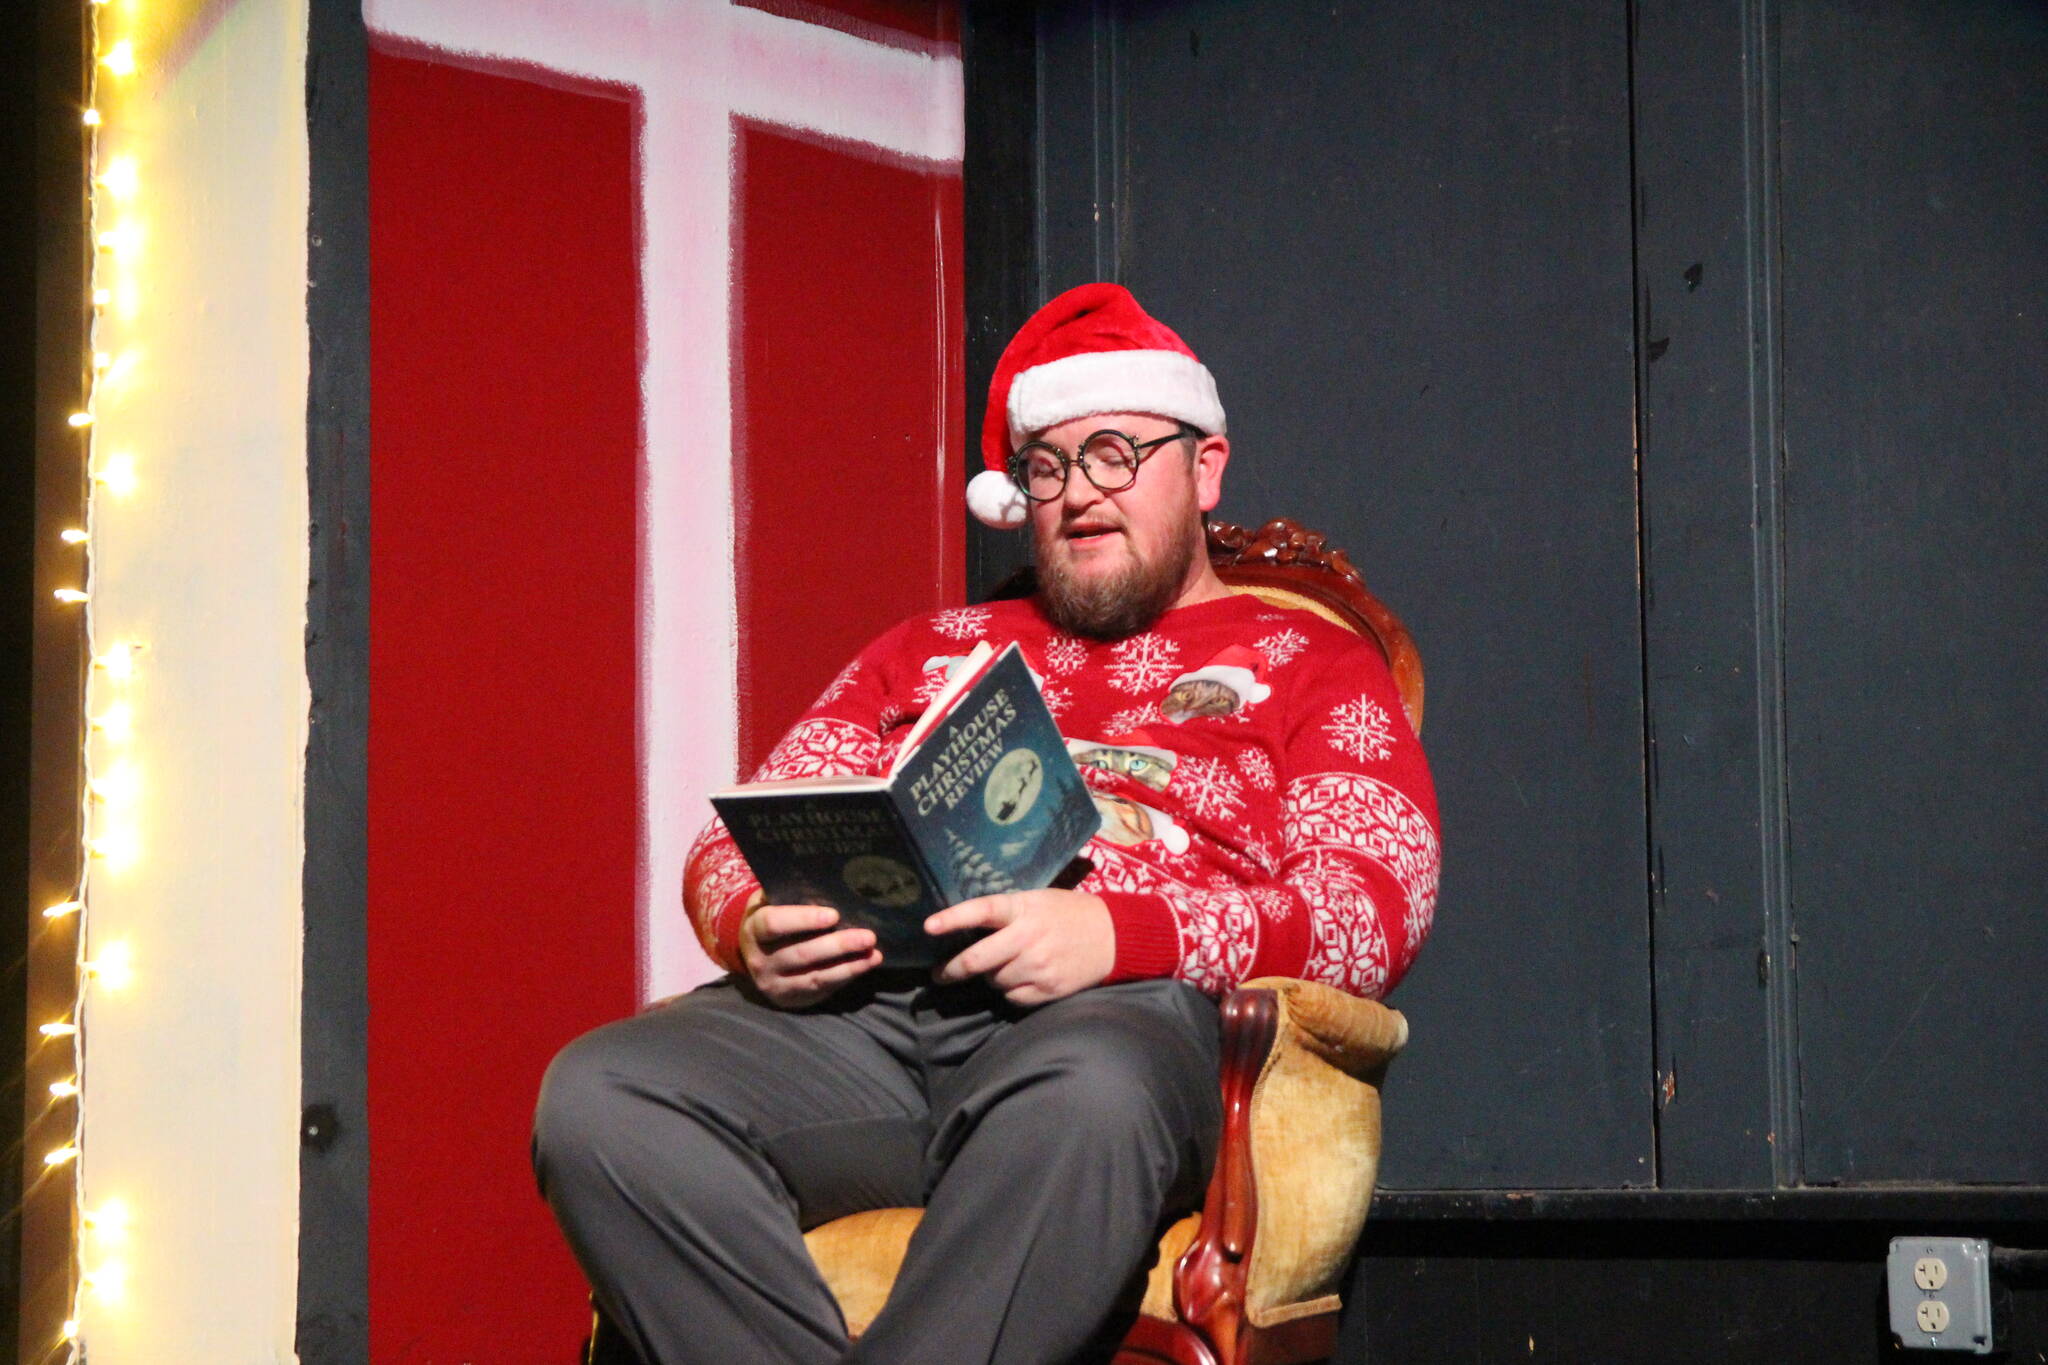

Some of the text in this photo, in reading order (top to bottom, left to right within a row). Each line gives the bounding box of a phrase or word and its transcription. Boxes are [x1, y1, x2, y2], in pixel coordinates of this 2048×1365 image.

[909, 688, 1010, 800] PLAYHOUSE
[917, 703, 1017, 816] CHRISTMAS
[944, 738, 1005, 810] REVIEW
[949, 725, 959, 739] A
